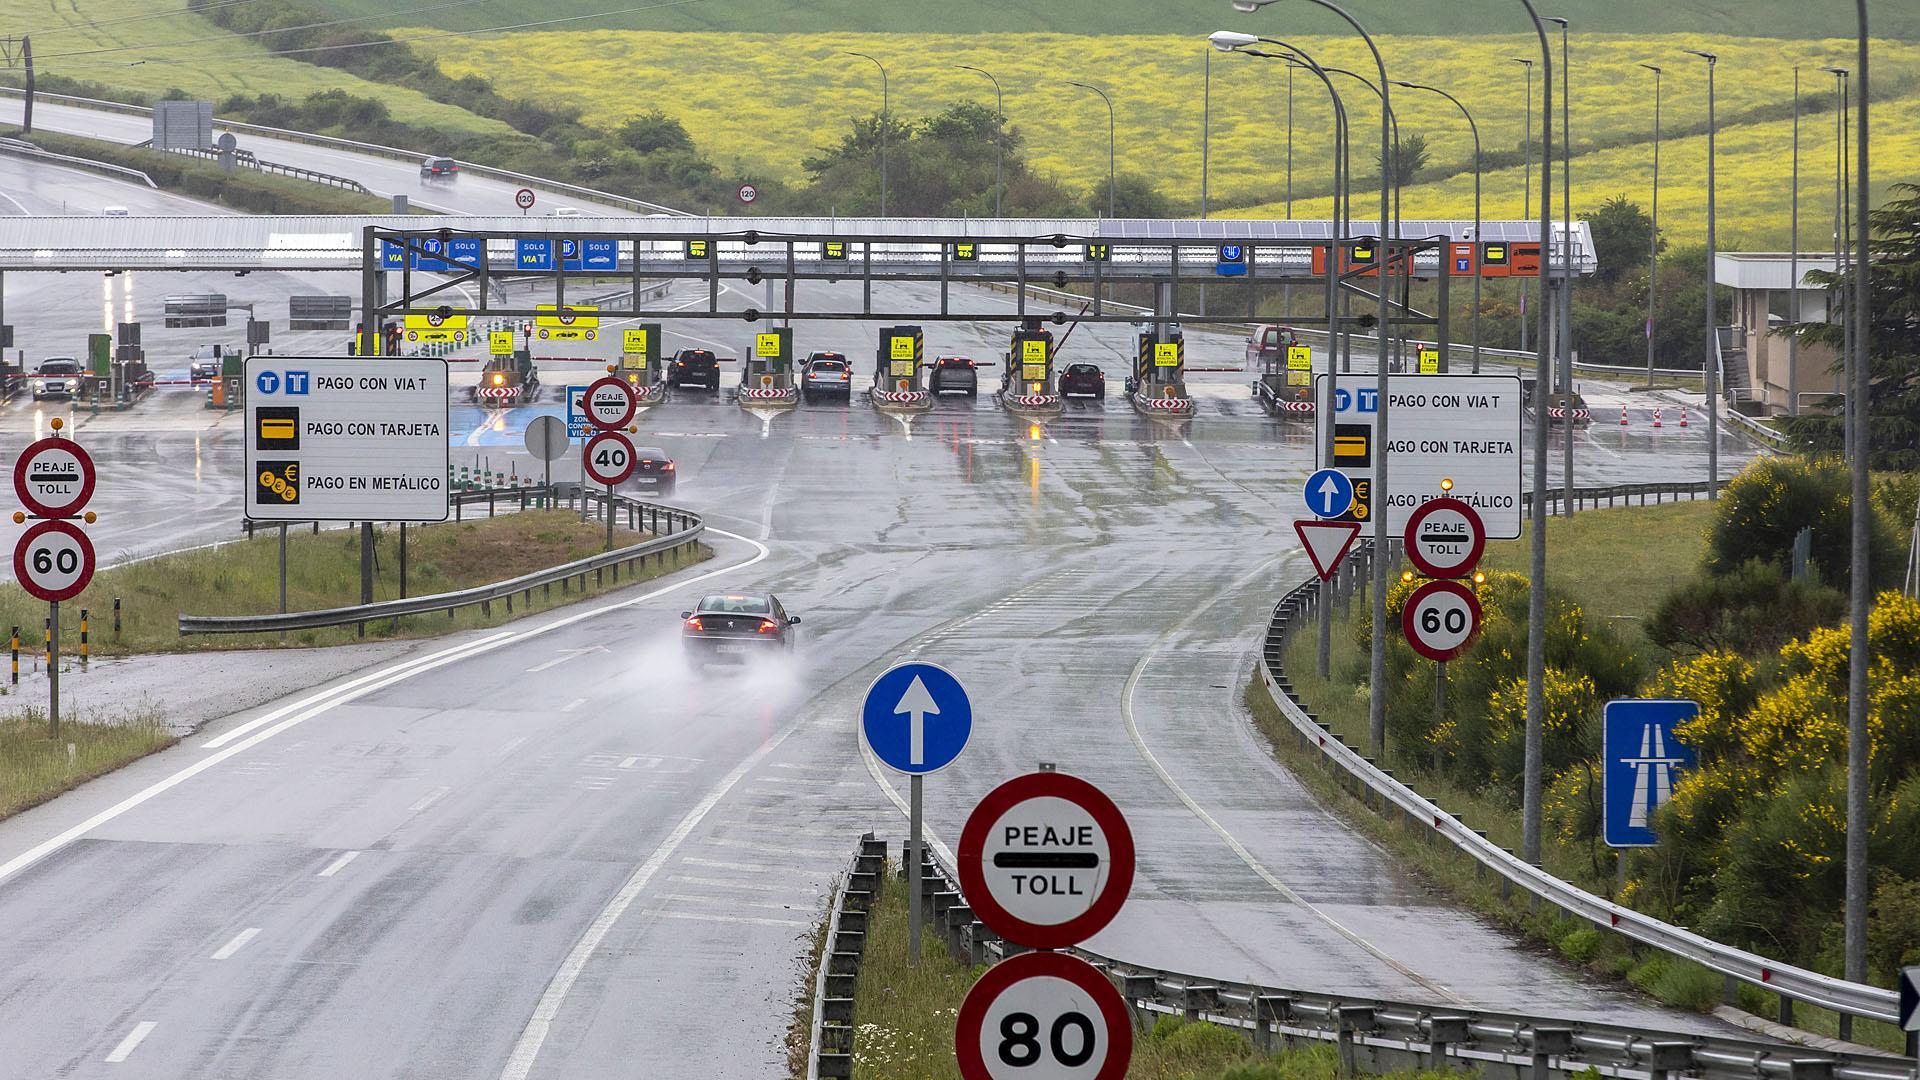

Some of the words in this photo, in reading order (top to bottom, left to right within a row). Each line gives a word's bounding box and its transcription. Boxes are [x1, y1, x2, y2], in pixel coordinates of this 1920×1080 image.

[742, 190, 754, 198] 120
[523, 255, 537, 263] VIA
[318, 377, 353, 389] PAGO
[360, 378, 387, 389] CON
[394, 378, 415, 390] VIA
[1390, 395, 1426, 407] PAGO
[1432, 396, 1459, 407] CON
[1467, 396, 1488, 408] VIA
[308, 423, 343, 435] PAGO
[348, 423, 375, 435] CON
[380, 424, 439, 435] TARJETA
[1387, 441, 1416, 453] AGO
[1421, 441, 1448, 453] CON
[1453, 442, 1513, 453] TARJETA
[595, 450, 626, 467] 40
[34, 463, 74, 472] PEAJE
[308, 477, 344, 489] PAGO
[350, 477, 366, 489] EN
[373, 474, 439, 490] METÁLICO
[38, 485, 71, 494] TOLL
[1387, 494, 1415, 507] AGO
[1425, 523, 1465, 532] PEAJE
[1429, 545, 1461, 554] TOLL
[33, 548, 77, 574] 60
[1422, 608, 1465, 633] 60
[1006, 827, 1092, 846] PEAJE
[1012, 876, 1082, 895] TOLL
[999, 1012, 1095, 1067] 80
